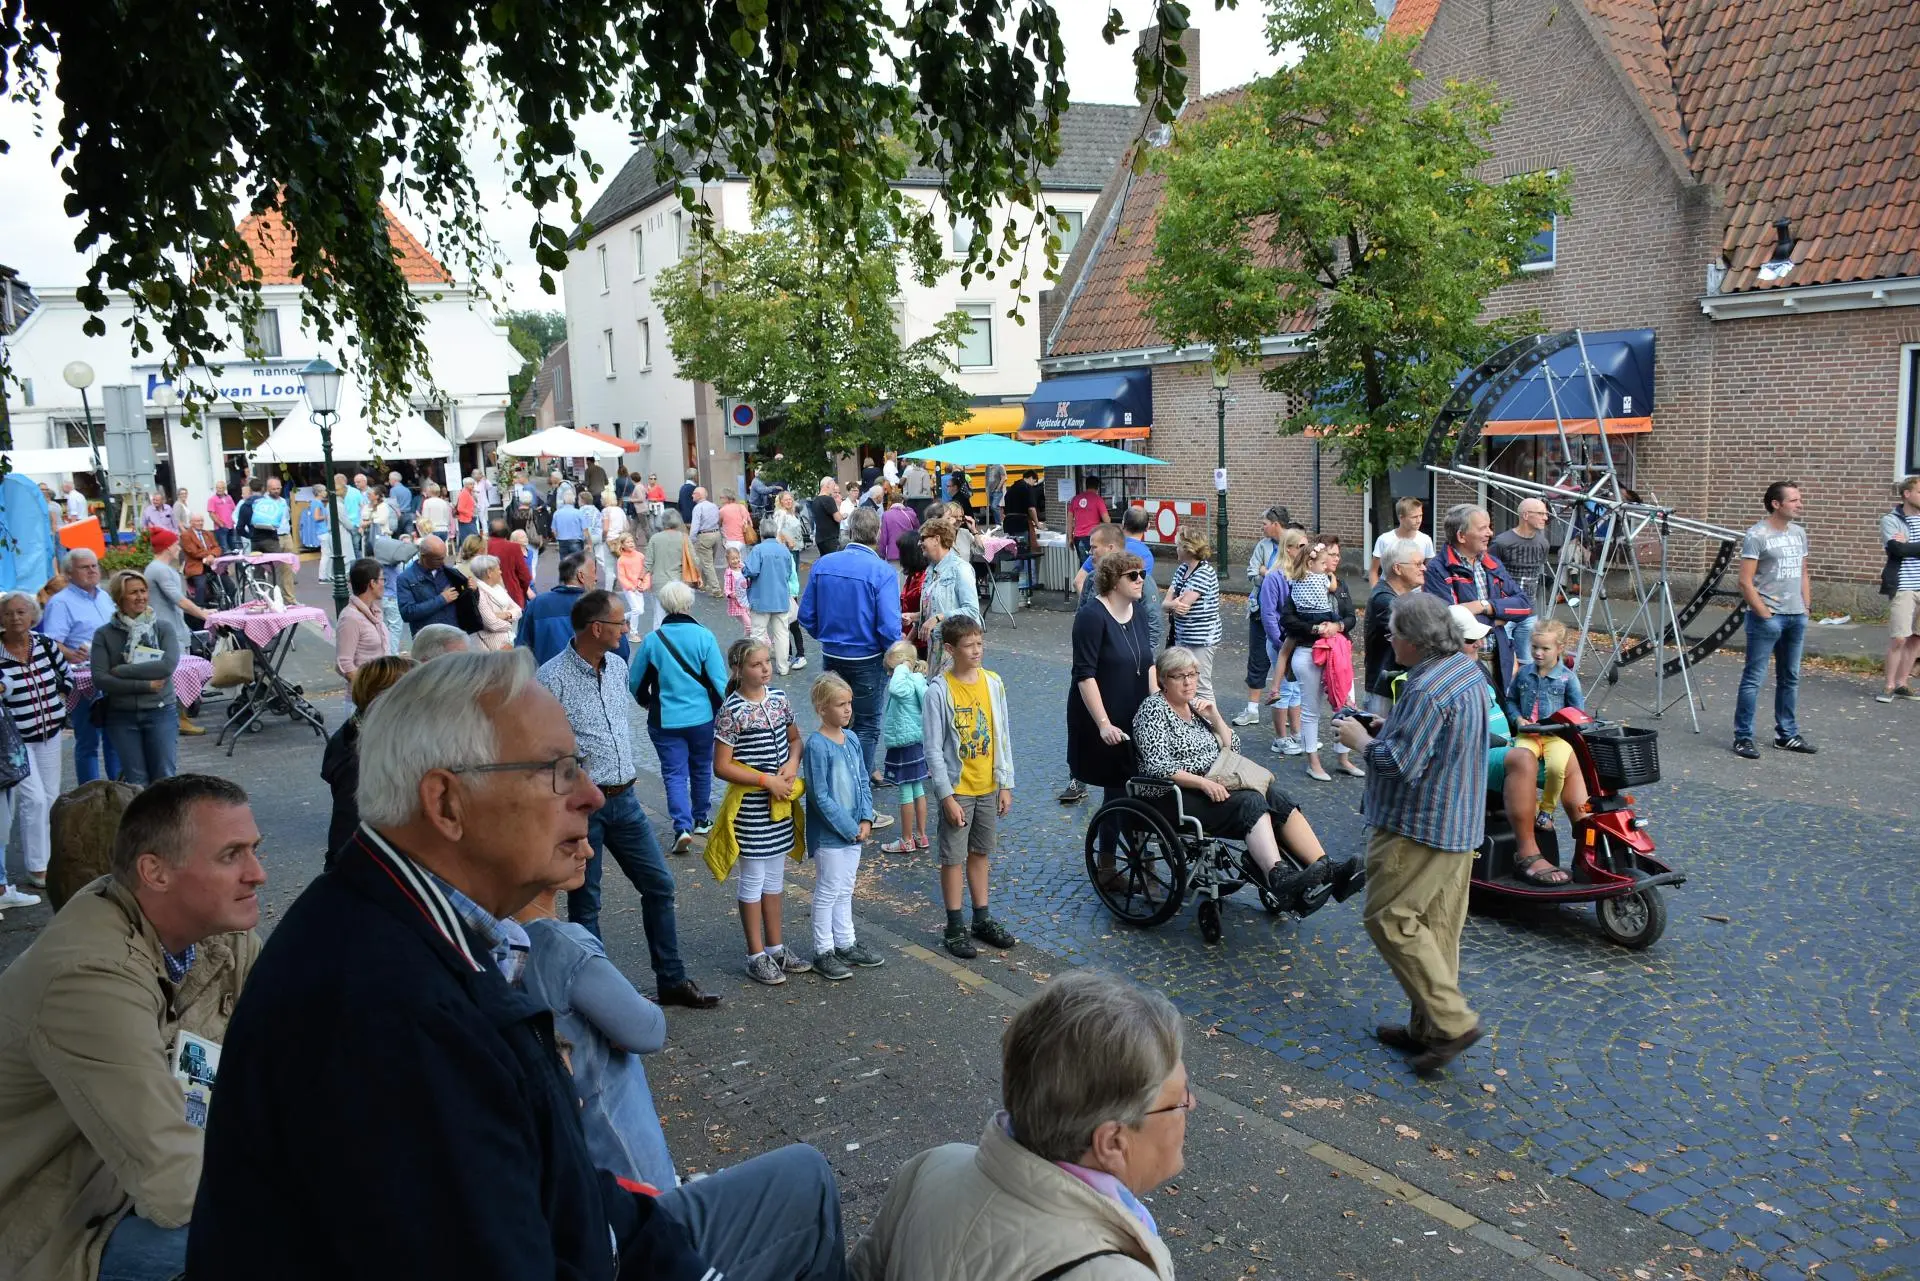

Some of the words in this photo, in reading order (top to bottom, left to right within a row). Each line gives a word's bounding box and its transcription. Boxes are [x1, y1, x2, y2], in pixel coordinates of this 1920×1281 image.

[220, 385, 252, 397] van
[261, 383, 306, 397] Loon
[1036, 417, 1061, 430] Hofstede
[1067, 417, 1085, 429] Kamp
